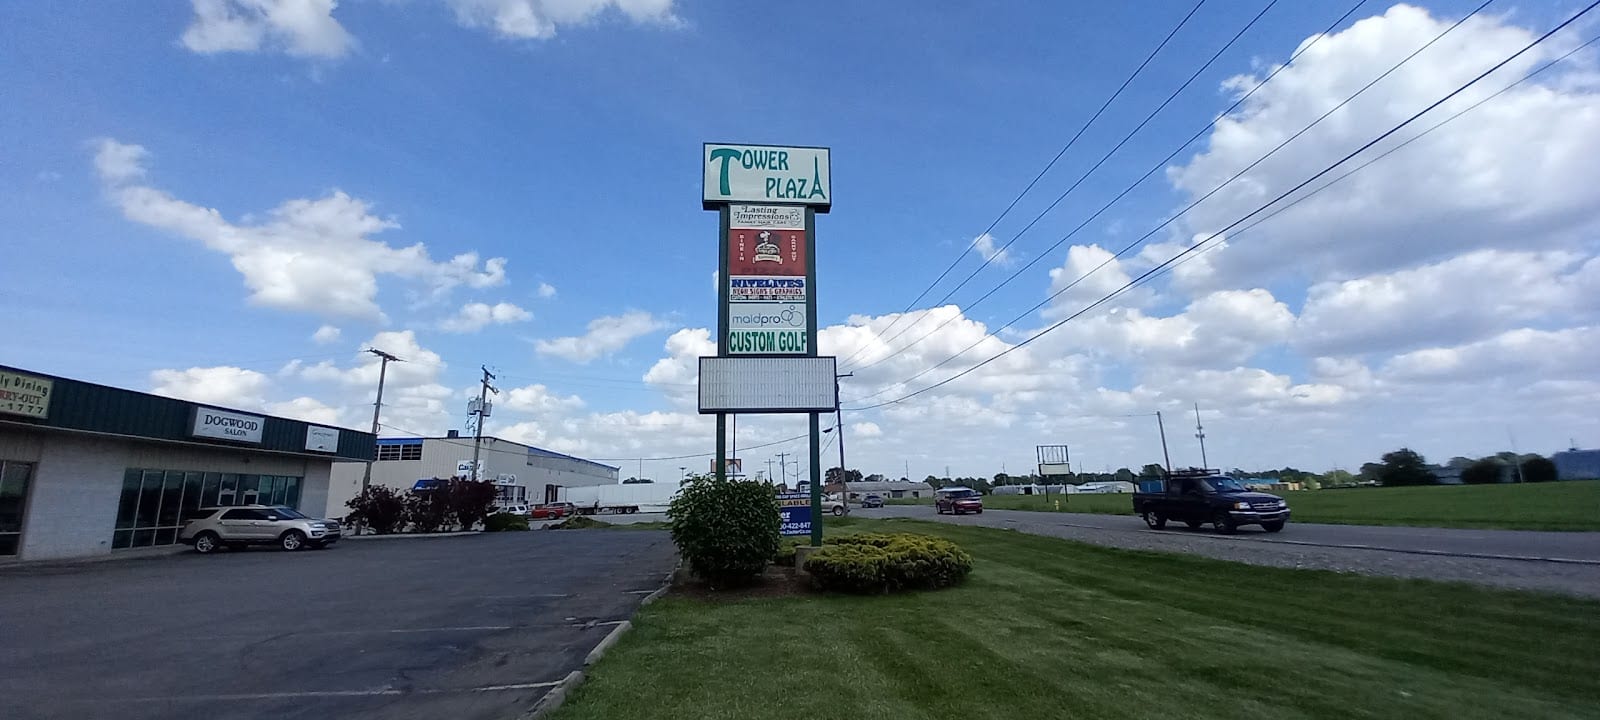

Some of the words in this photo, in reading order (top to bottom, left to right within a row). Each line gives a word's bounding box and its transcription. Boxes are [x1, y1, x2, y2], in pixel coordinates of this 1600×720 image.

[710, 148, 789, 195] TOWER
[766, 154, 826, 199] PLAZA
[734, 211, 789, 220] Impressions
[742, 205, 778, 214] Lasting
[731, 279, 804, 288] NITELITES
[732, 313, 781, 327] maidpro
[730, 332, 775, 352] CUSTOM
[779, 332, 806, 352] GOLF
[14, 376, 48, 397] Dining
[204, 415, 258, 431] DOGWOOD
[224, 427, 247, 437] SALON
